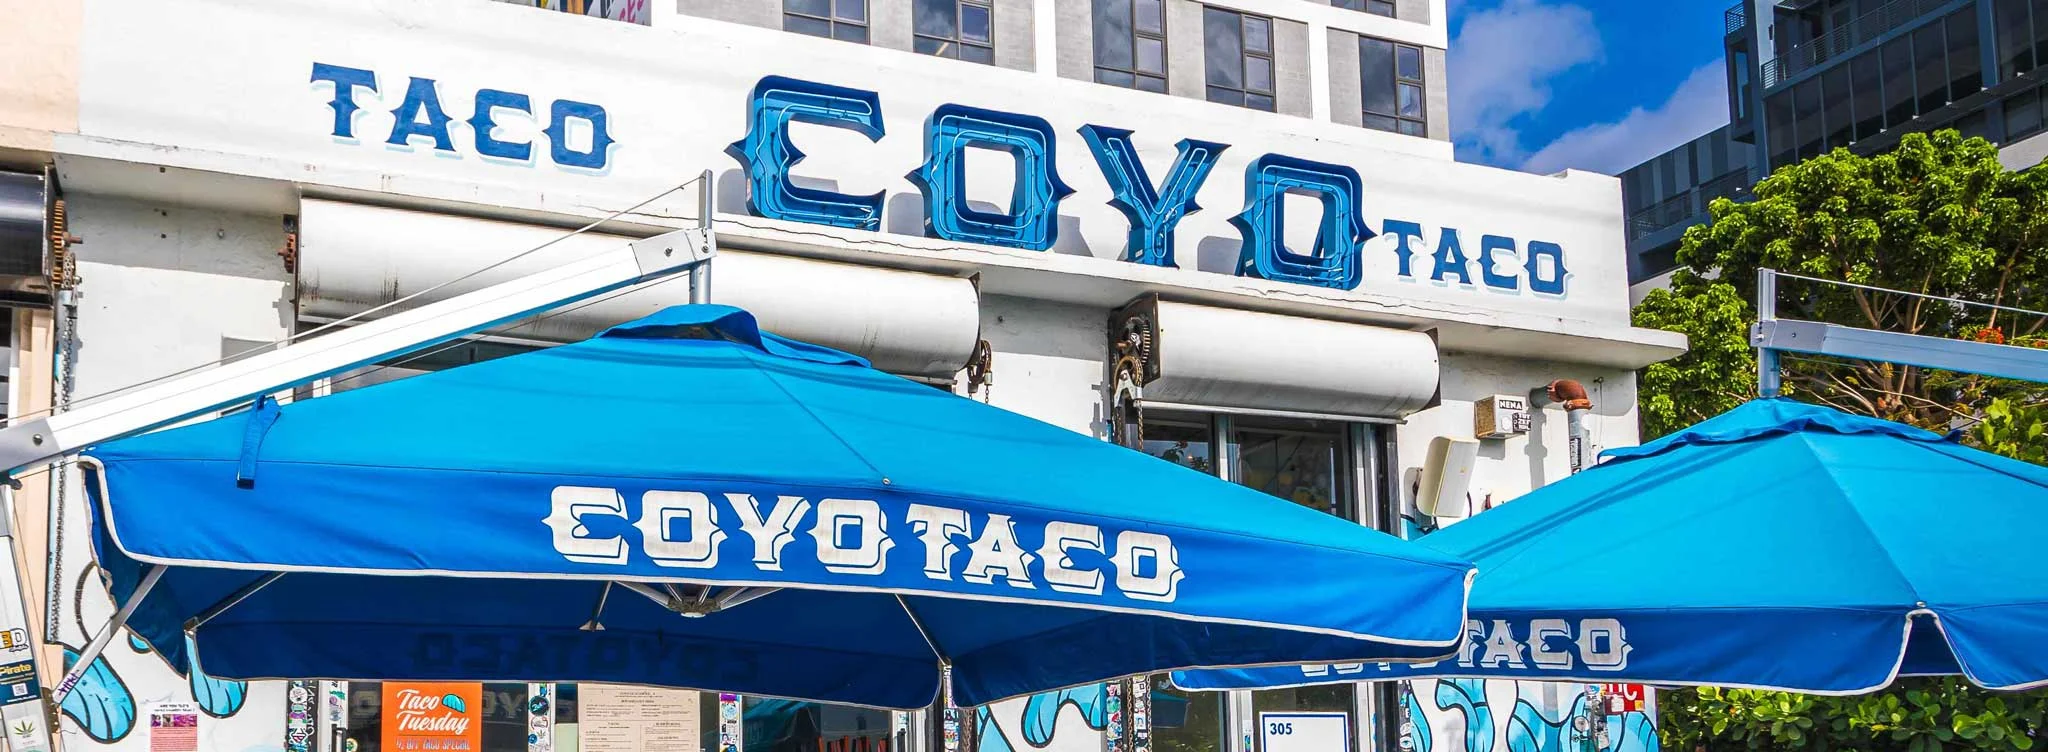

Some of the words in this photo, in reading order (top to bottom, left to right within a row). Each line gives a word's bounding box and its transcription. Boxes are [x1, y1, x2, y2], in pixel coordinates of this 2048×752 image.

[310, 62, 619, 172] TACO
[724, 75, 1376, 290] COYO
[1382, 219, 1571, 297] TACO
[396, 689, 440, 710] Taco
[396, 710, 469, 735] Tuesday
[1270, 723, 1293, 735] 305
